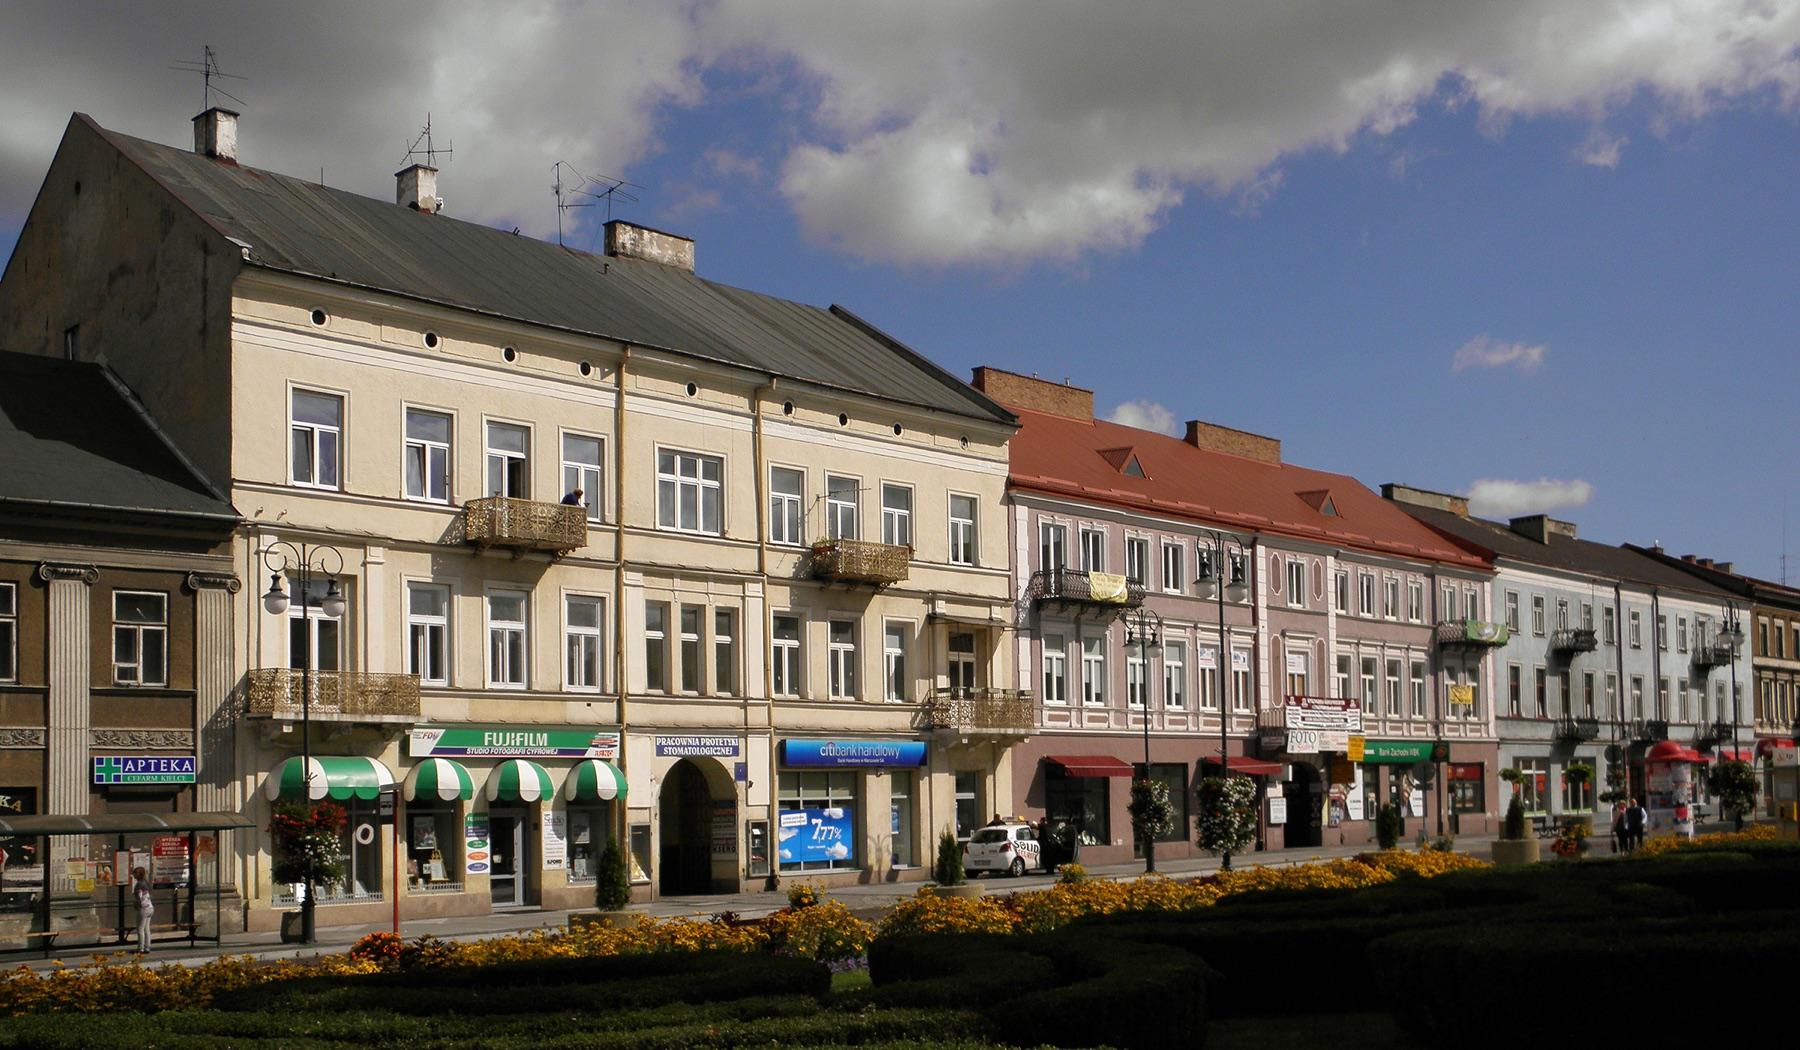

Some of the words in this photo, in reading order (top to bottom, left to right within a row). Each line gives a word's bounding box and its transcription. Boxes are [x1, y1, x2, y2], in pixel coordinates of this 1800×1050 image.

[484, 732, 548, 747] FUJIFILM
[656, 737, 700, 746] PRACOWNIA
[700, 738, 739, 746] PROTETYKI
[1290, 731, 1316, 744] FOTO
[466, 747, 490, 755] STUDIO
[490, 747, 526, 755] FOTOGRAFII
[663, 747, 733, 755] STOMATOLOGICZNEJ
[820, 742, 857, 757] citibank
[858, 744, 900, 759] handlowy
[125, 760, 192, 771] APTEKA
[1013, 841, 1039, 854] SOLID
